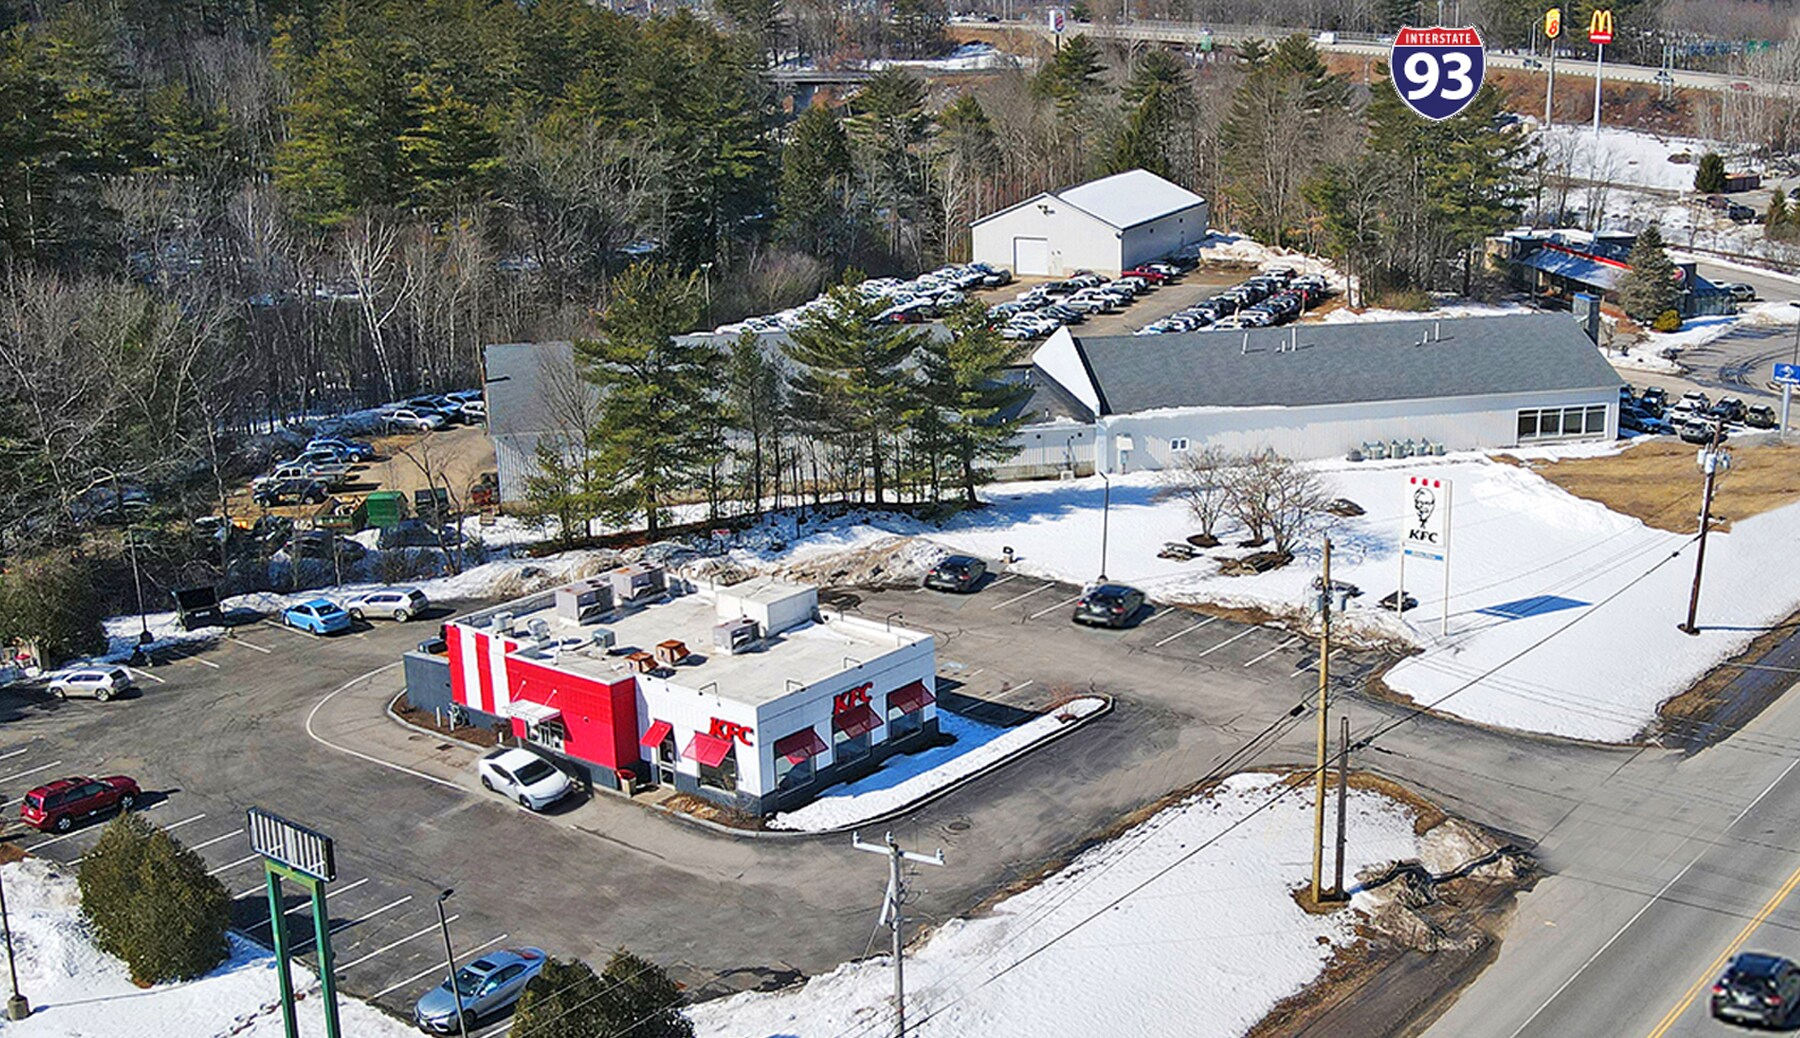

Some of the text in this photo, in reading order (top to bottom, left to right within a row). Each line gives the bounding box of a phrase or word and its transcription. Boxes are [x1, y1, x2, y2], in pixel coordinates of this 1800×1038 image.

[1549, 20, 1559, 35] 8
[1409, 529, 1438, 543] KFC
[832, 681, 873, 715] KFC
[708, 716, 754, 747] KFC
